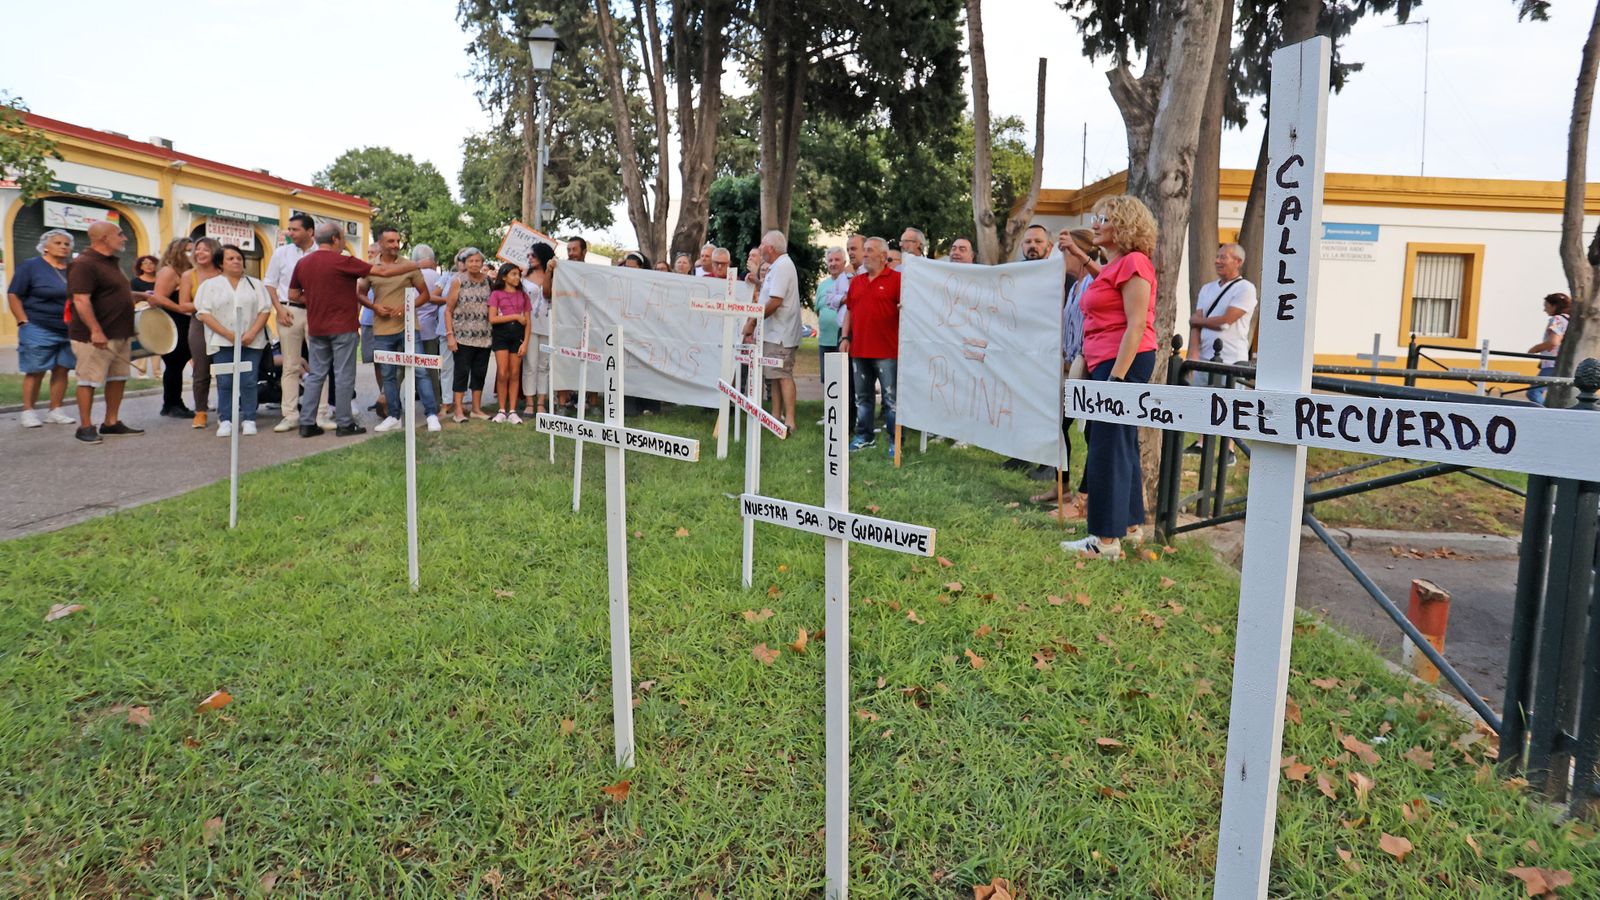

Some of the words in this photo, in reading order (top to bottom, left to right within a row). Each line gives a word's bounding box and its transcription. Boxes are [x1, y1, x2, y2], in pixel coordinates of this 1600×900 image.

[1276, 154, 1304, 320] CALLE
[403, 355, 412, 364] LOS
[415, 356, 439, 367] REMEDIOS
[606, 333, 616, 418] CALLE
[928, 356, 1013, 431] RUINA
[539, 417, 573, 434] NUESTRA
[602, 428, 620, 444] DEL
[626, 432, 690, 457] DESAMPARO
[827, 381, 838, 476] CALLE
[1211, 392, 1279, 436] DEL
[1295, 397, 1517, 455] RECUERDO
[744, 499, 788, 521] NUESTRA
[828, 516, 847, 534] DE
